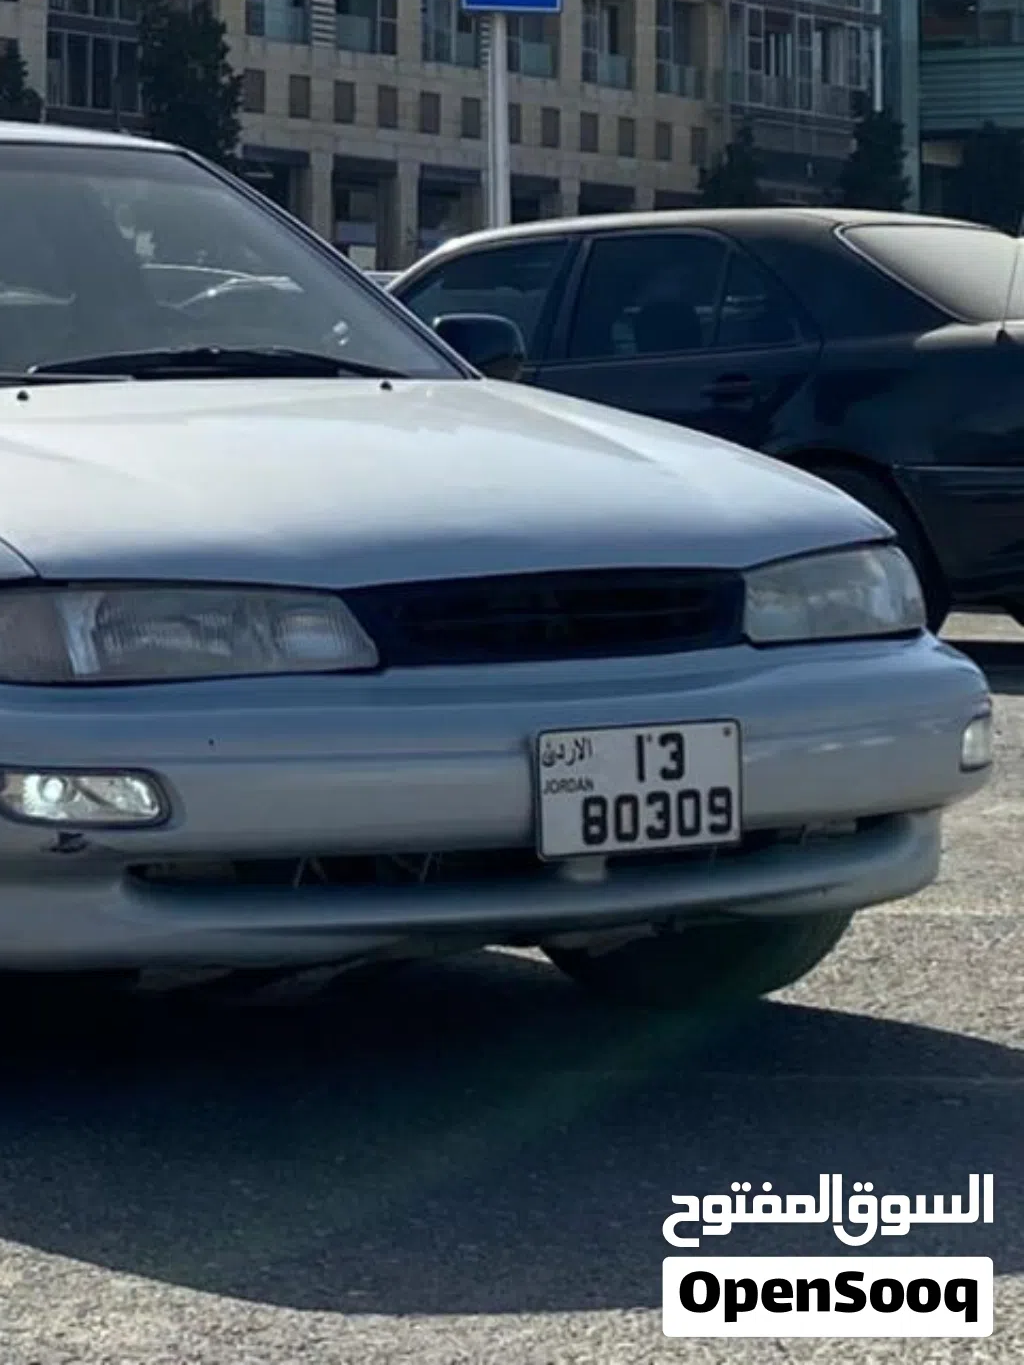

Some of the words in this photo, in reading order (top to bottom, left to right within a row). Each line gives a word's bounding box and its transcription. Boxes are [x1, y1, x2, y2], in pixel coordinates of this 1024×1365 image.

[635, 732, 685, 783] 13
[543, 776, 594, 795] JORDAN
[581, 786, 732, 846] 80309
